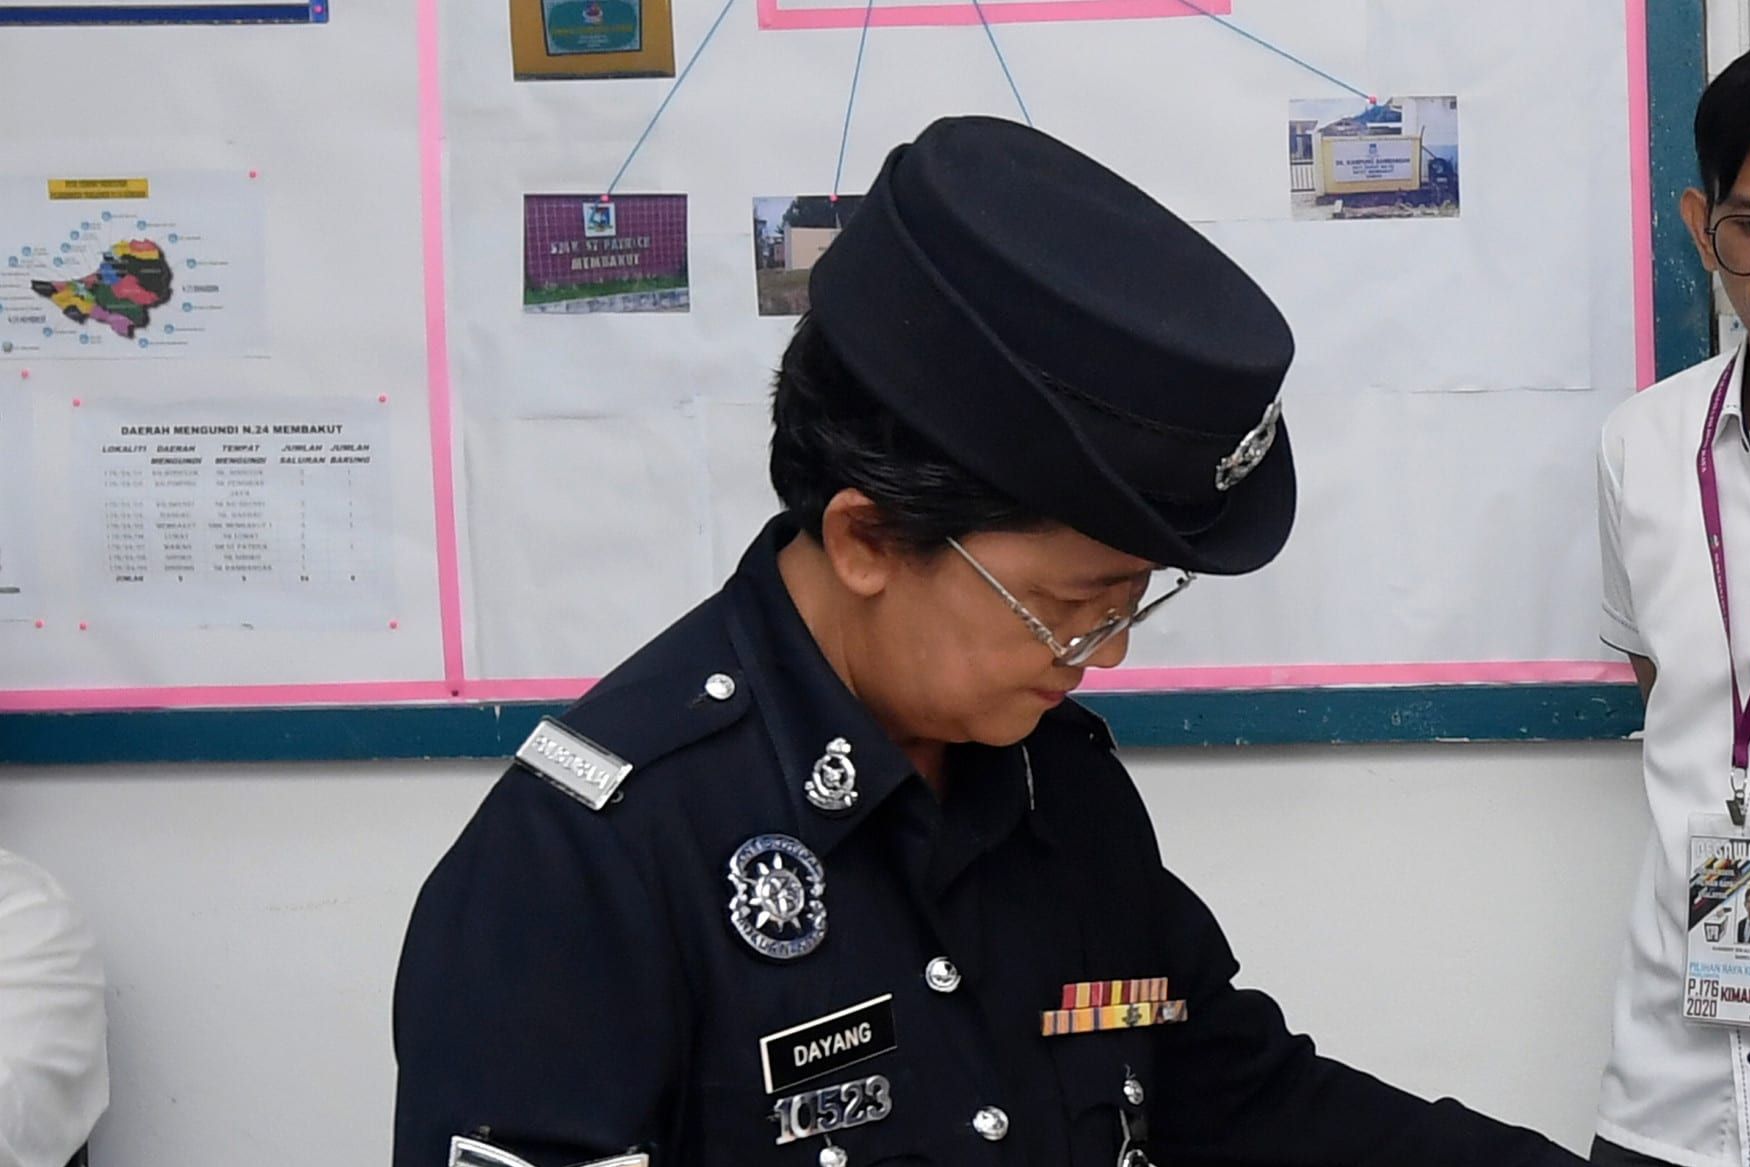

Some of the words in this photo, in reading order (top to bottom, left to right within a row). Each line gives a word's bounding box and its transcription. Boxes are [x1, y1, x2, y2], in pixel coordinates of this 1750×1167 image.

[120, 424, 171, 436] DAERAH
[172, 424, 240, 436] MENGUNDI
[242, 424, 270, 435] N.24
[272, 423, 344, 435] MEMBAKUT
[1688, 977, 1720, 998] P.176
[1686, 997, 1718, 1018] 2020
[793, 1021, 873, 1067] DAYANG
[774, 1074, 893, 1146] 10523
